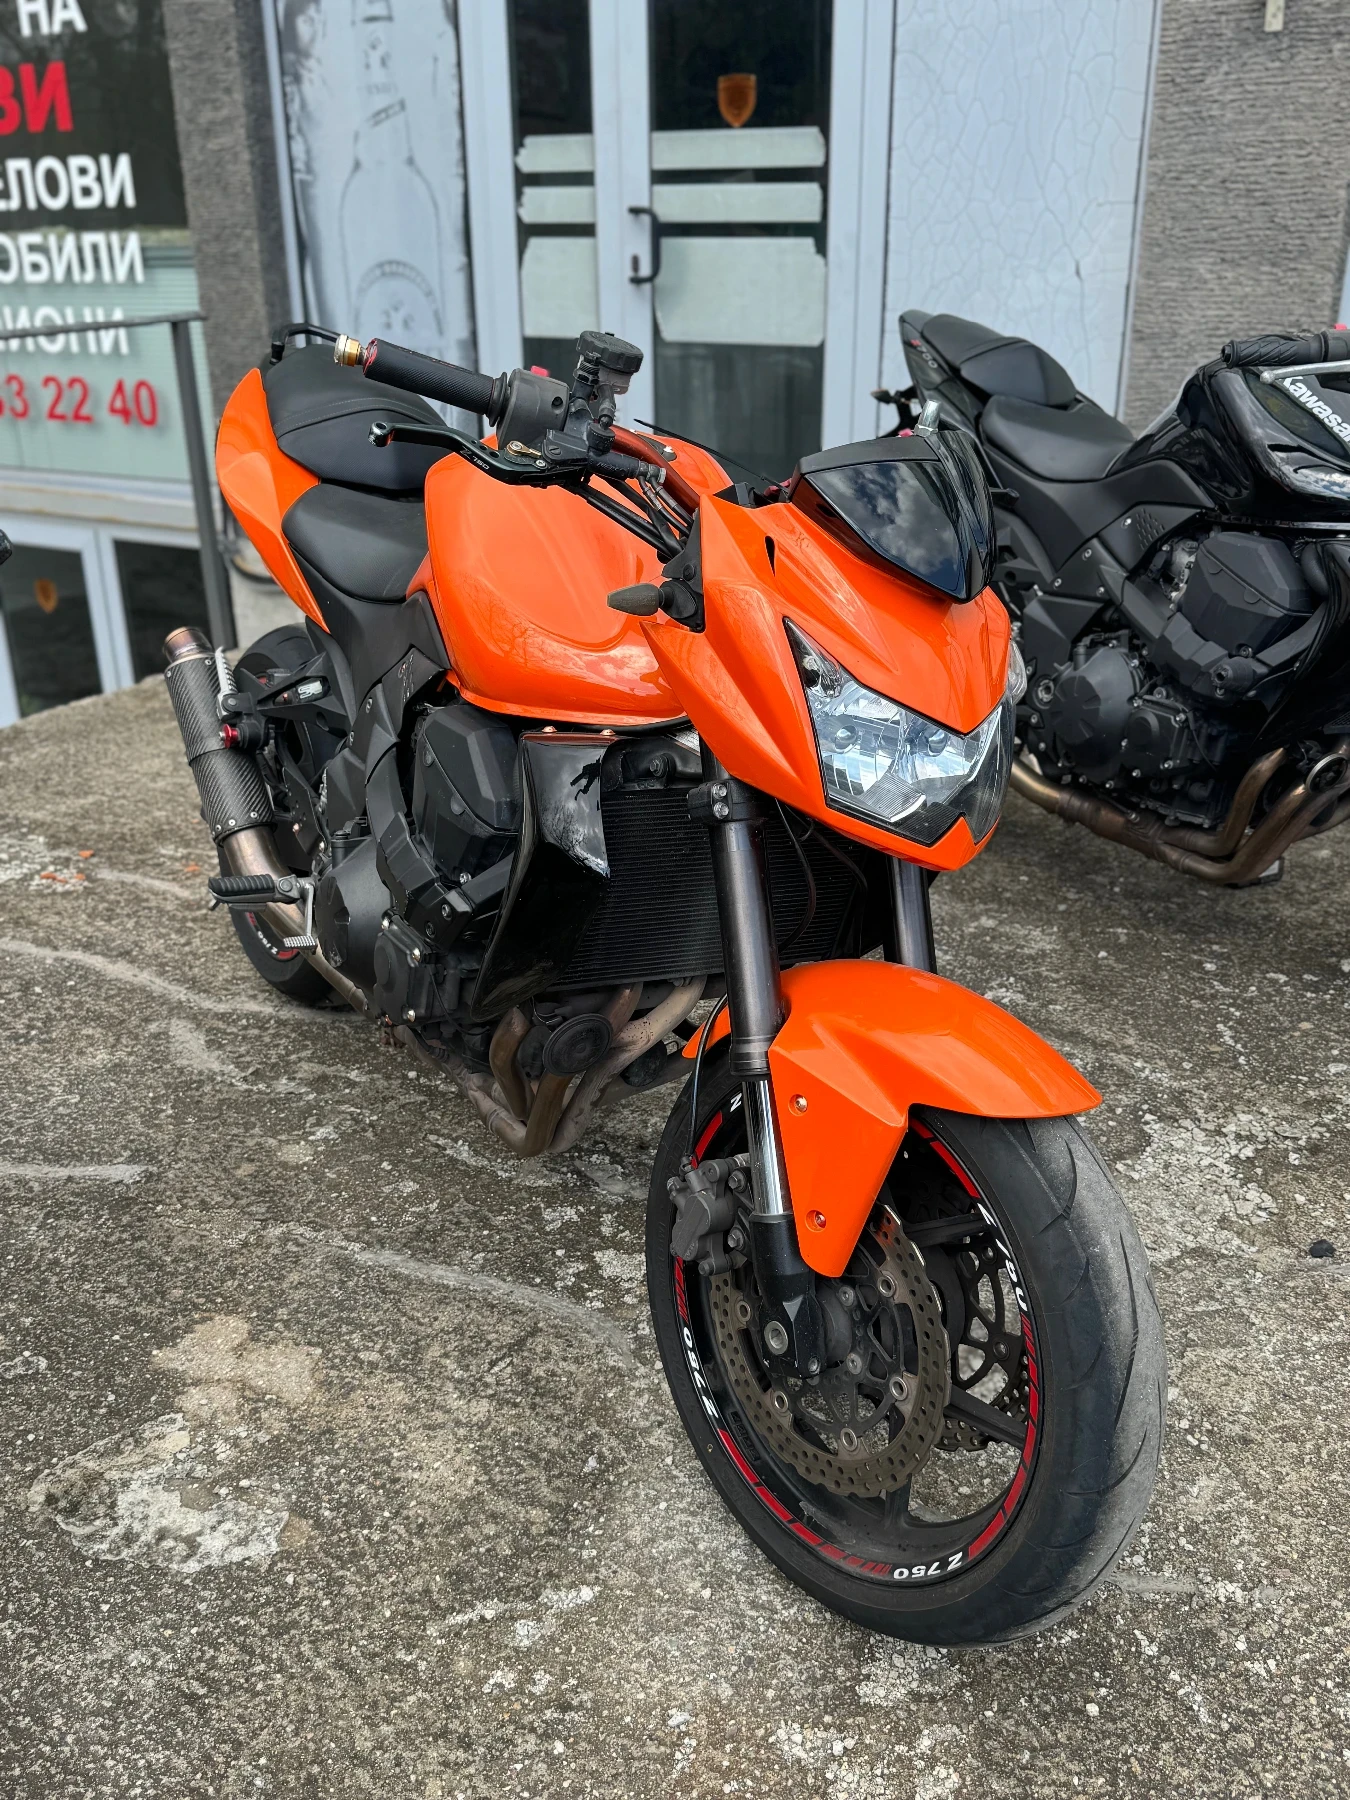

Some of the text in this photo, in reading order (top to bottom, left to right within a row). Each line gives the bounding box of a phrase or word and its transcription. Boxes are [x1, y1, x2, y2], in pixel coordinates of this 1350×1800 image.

[0, 304, 129, 355] ИОНИ
[0, 374, 157, 428] 3 22 40
[683, 1326, 719, 1419] Z 750
[893, 1551, 963, 1580] Z 750
